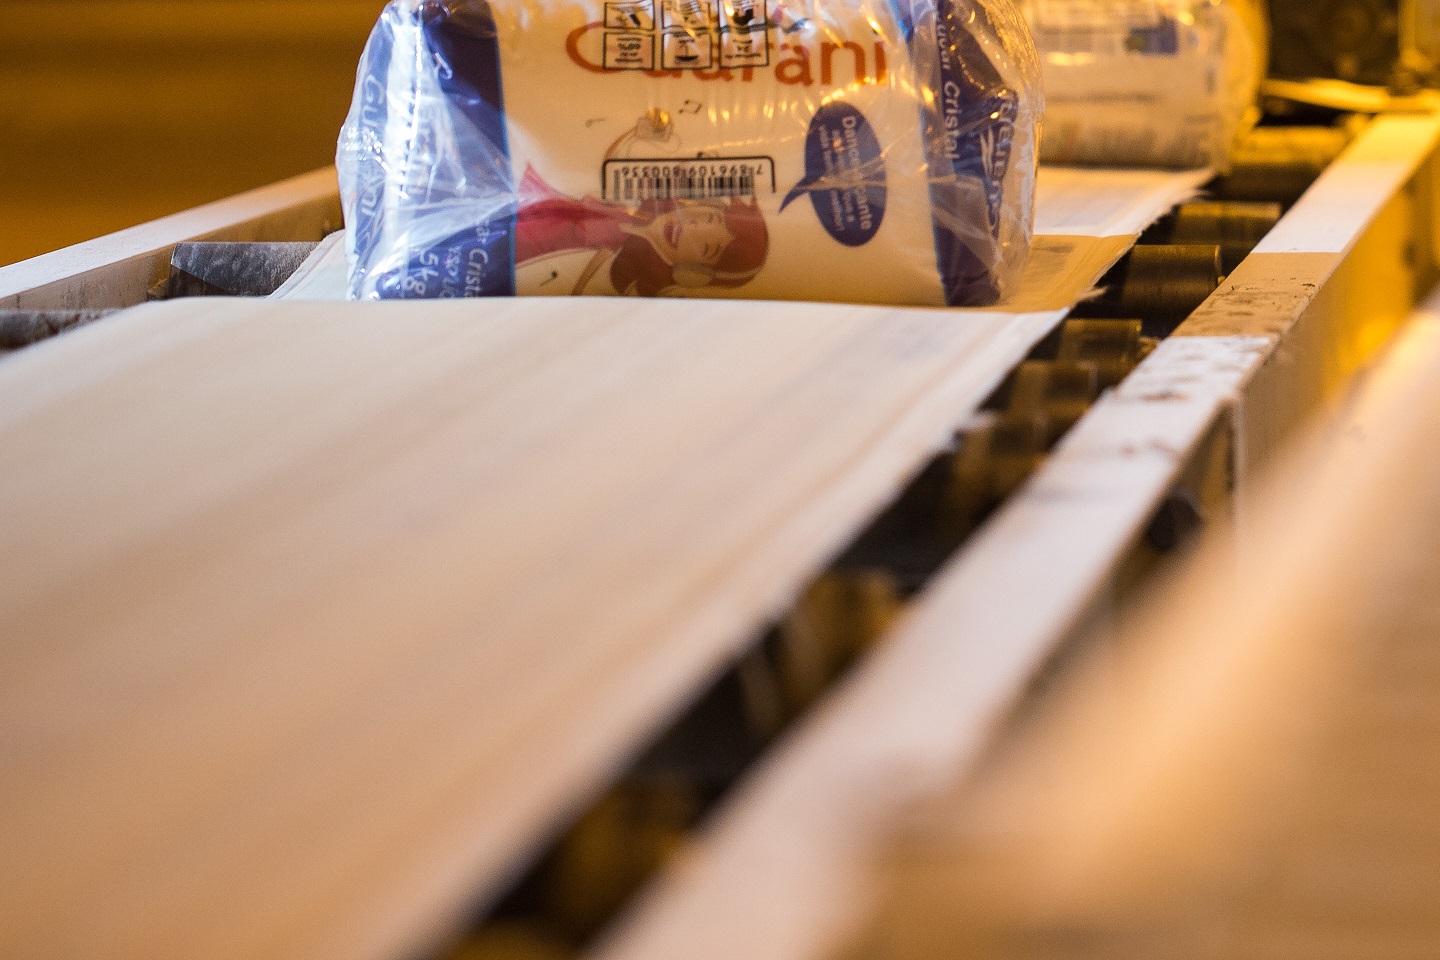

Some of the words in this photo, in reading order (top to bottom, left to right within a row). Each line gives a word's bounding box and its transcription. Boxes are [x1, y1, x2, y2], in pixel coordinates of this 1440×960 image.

[565, 20, 888, 87] Guarani
[361, 74, 385, 217] Guani
[943, 80, 961, 160] Cristal
[464, 248, 490, 298] Crista
